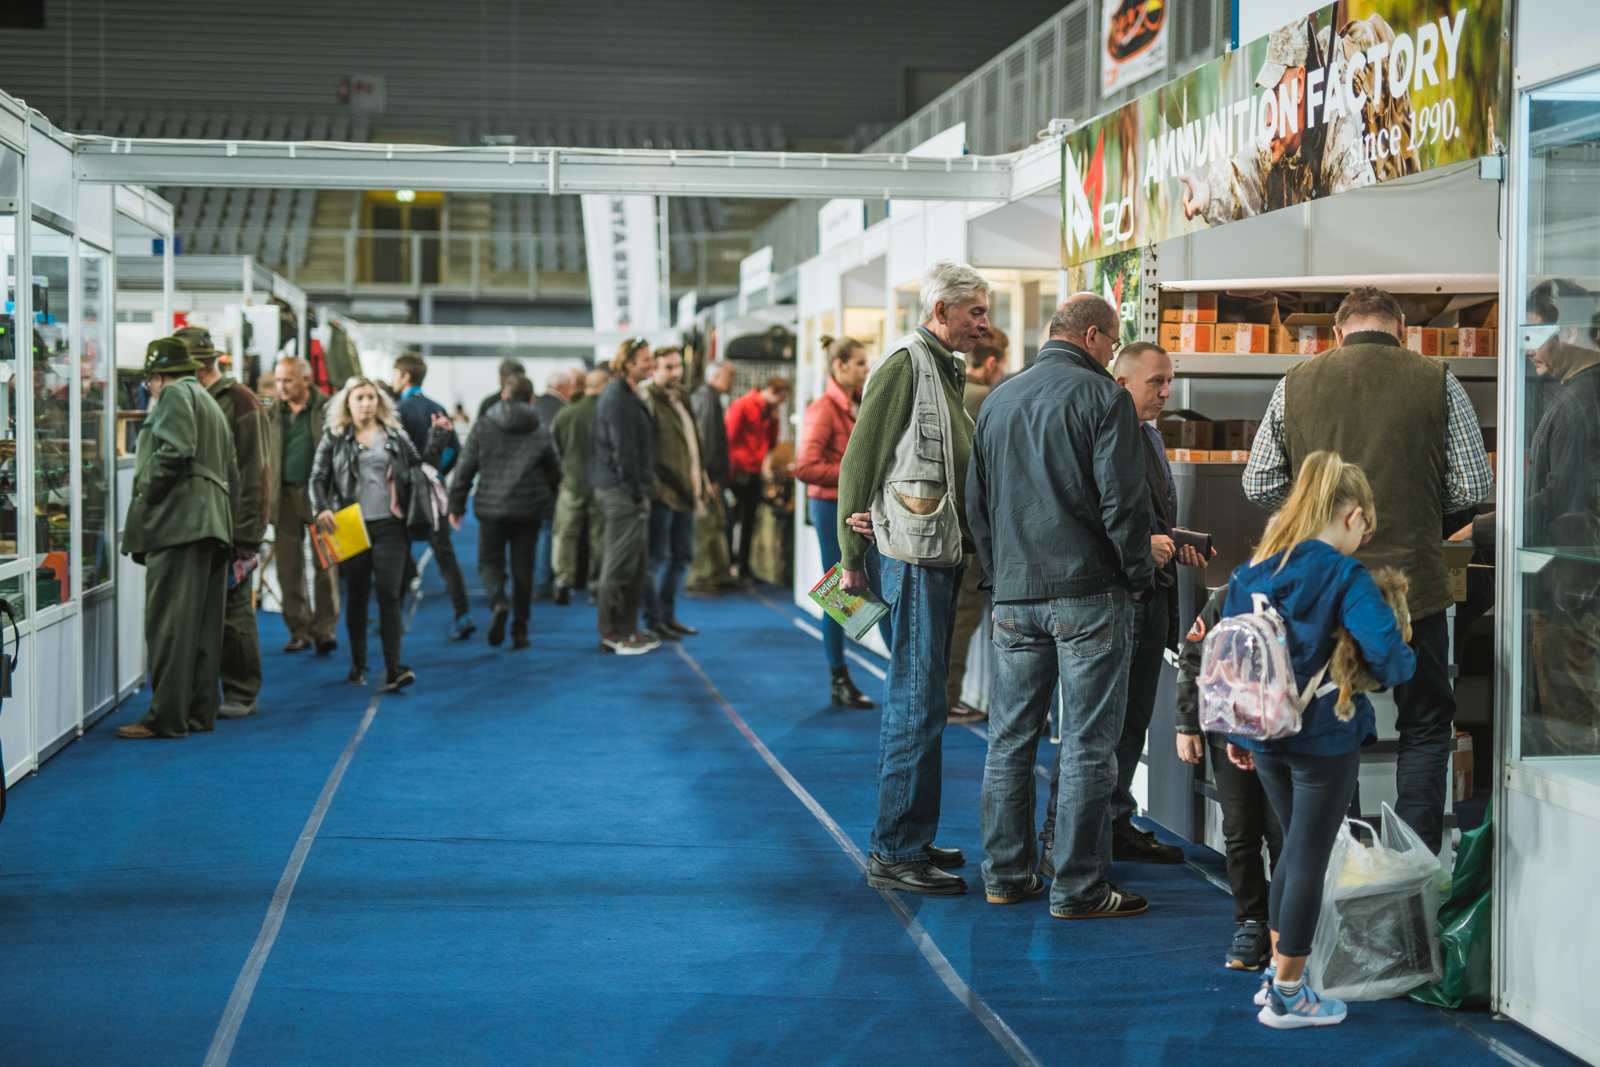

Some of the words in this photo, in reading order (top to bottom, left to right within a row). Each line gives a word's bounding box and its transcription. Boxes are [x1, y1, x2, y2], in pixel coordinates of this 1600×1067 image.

[1143, 78, 1299, 188] AMMUNITION
[1306, 8, 1467, 129] FACTORY
[1349, 123, 1402, 167] since
[1406, 97, 1460, 152] 1990.
